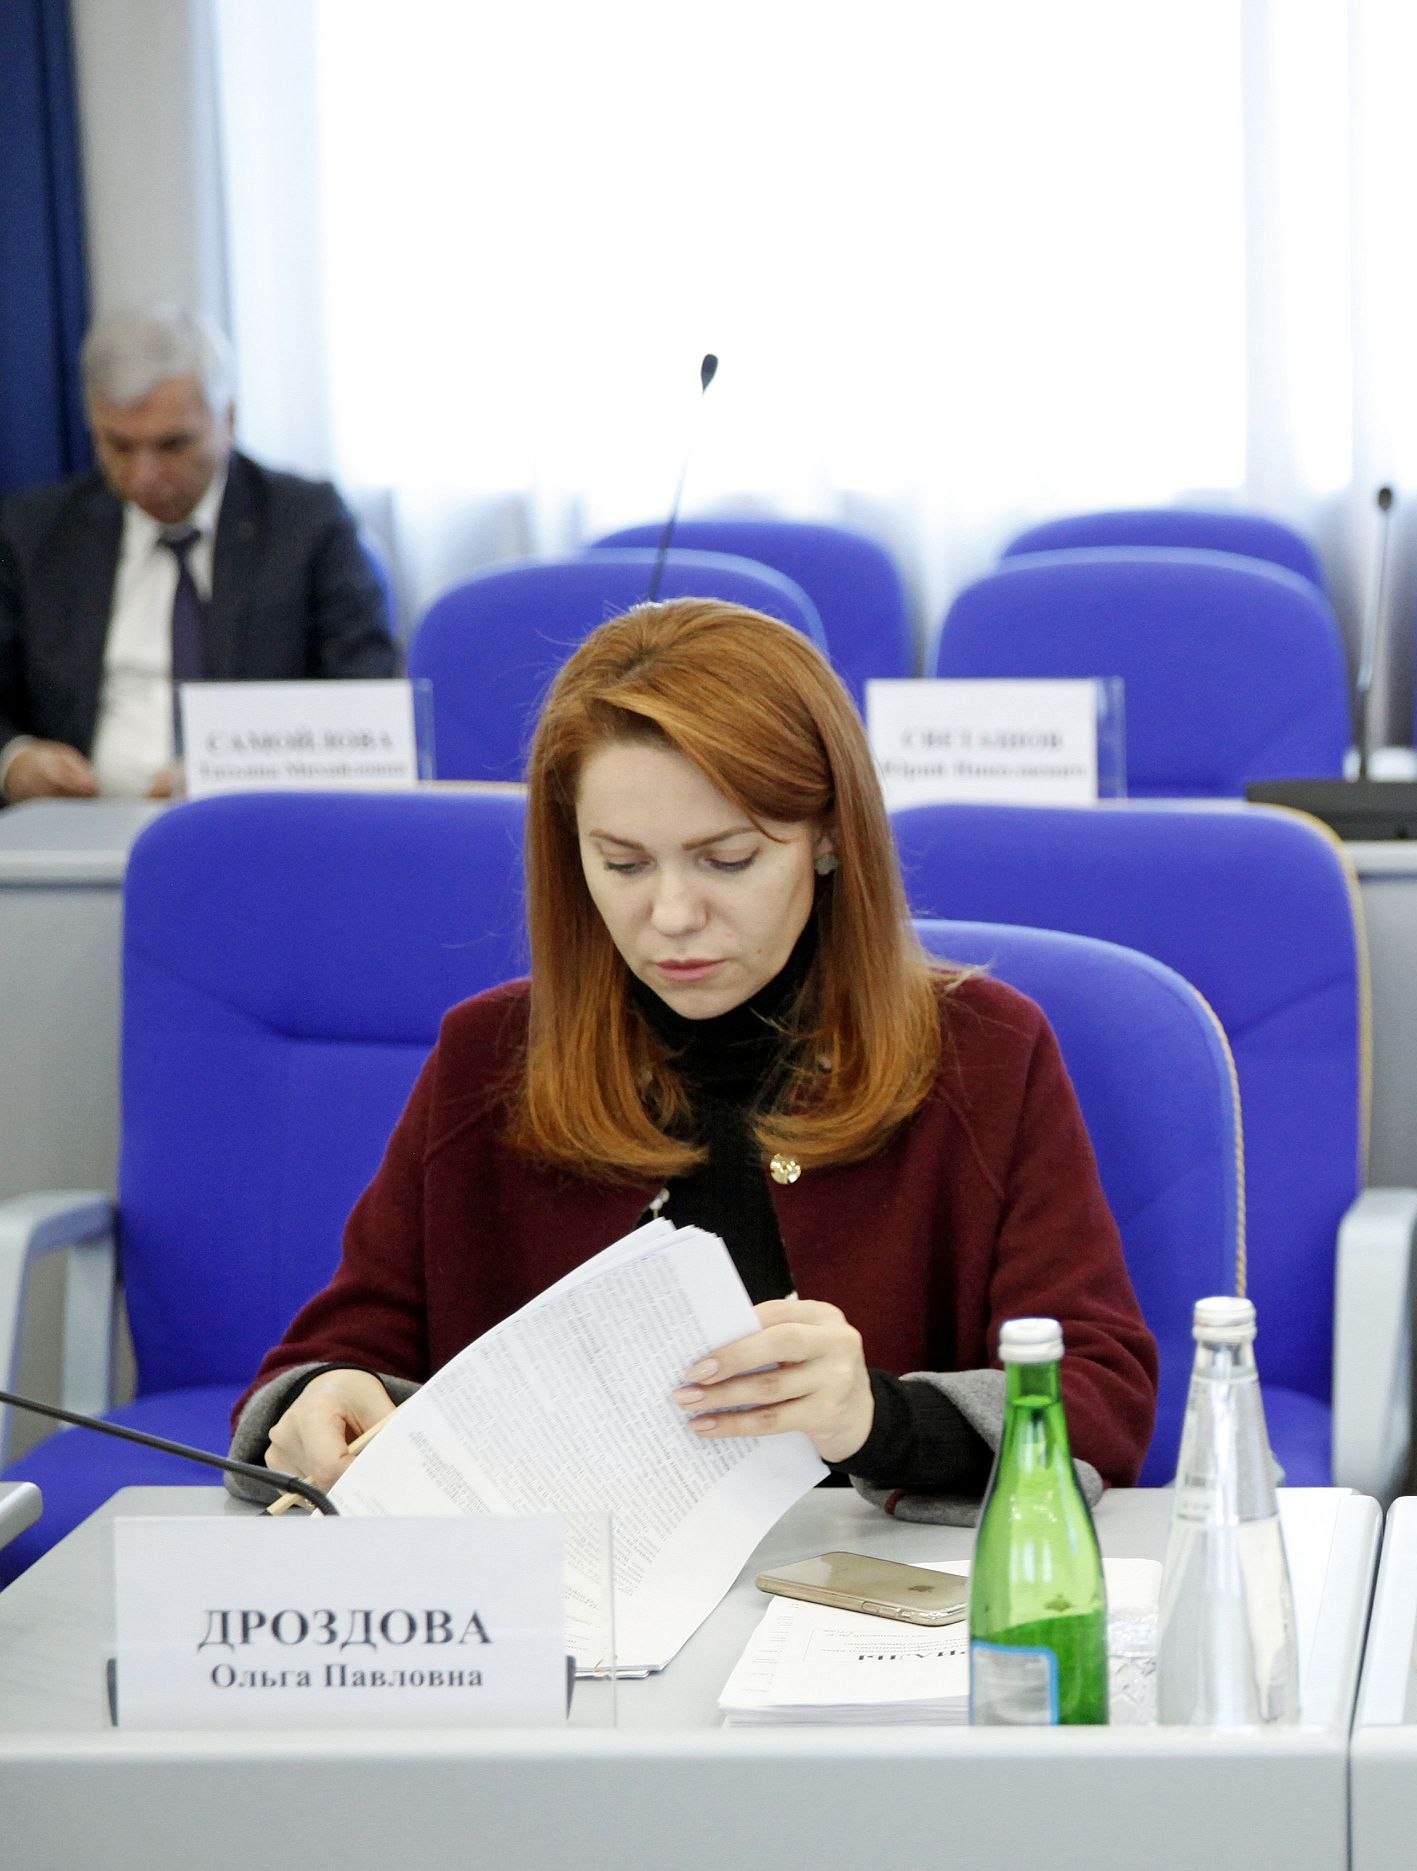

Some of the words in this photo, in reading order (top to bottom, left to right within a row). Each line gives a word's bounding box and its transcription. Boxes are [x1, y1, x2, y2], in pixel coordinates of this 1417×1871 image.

[197, 1609, 492, 1651] ДРОЗДОВА
[210, 1664, 311, 1688] Ольга
[324, 1663, 483, 1688] Павловна
